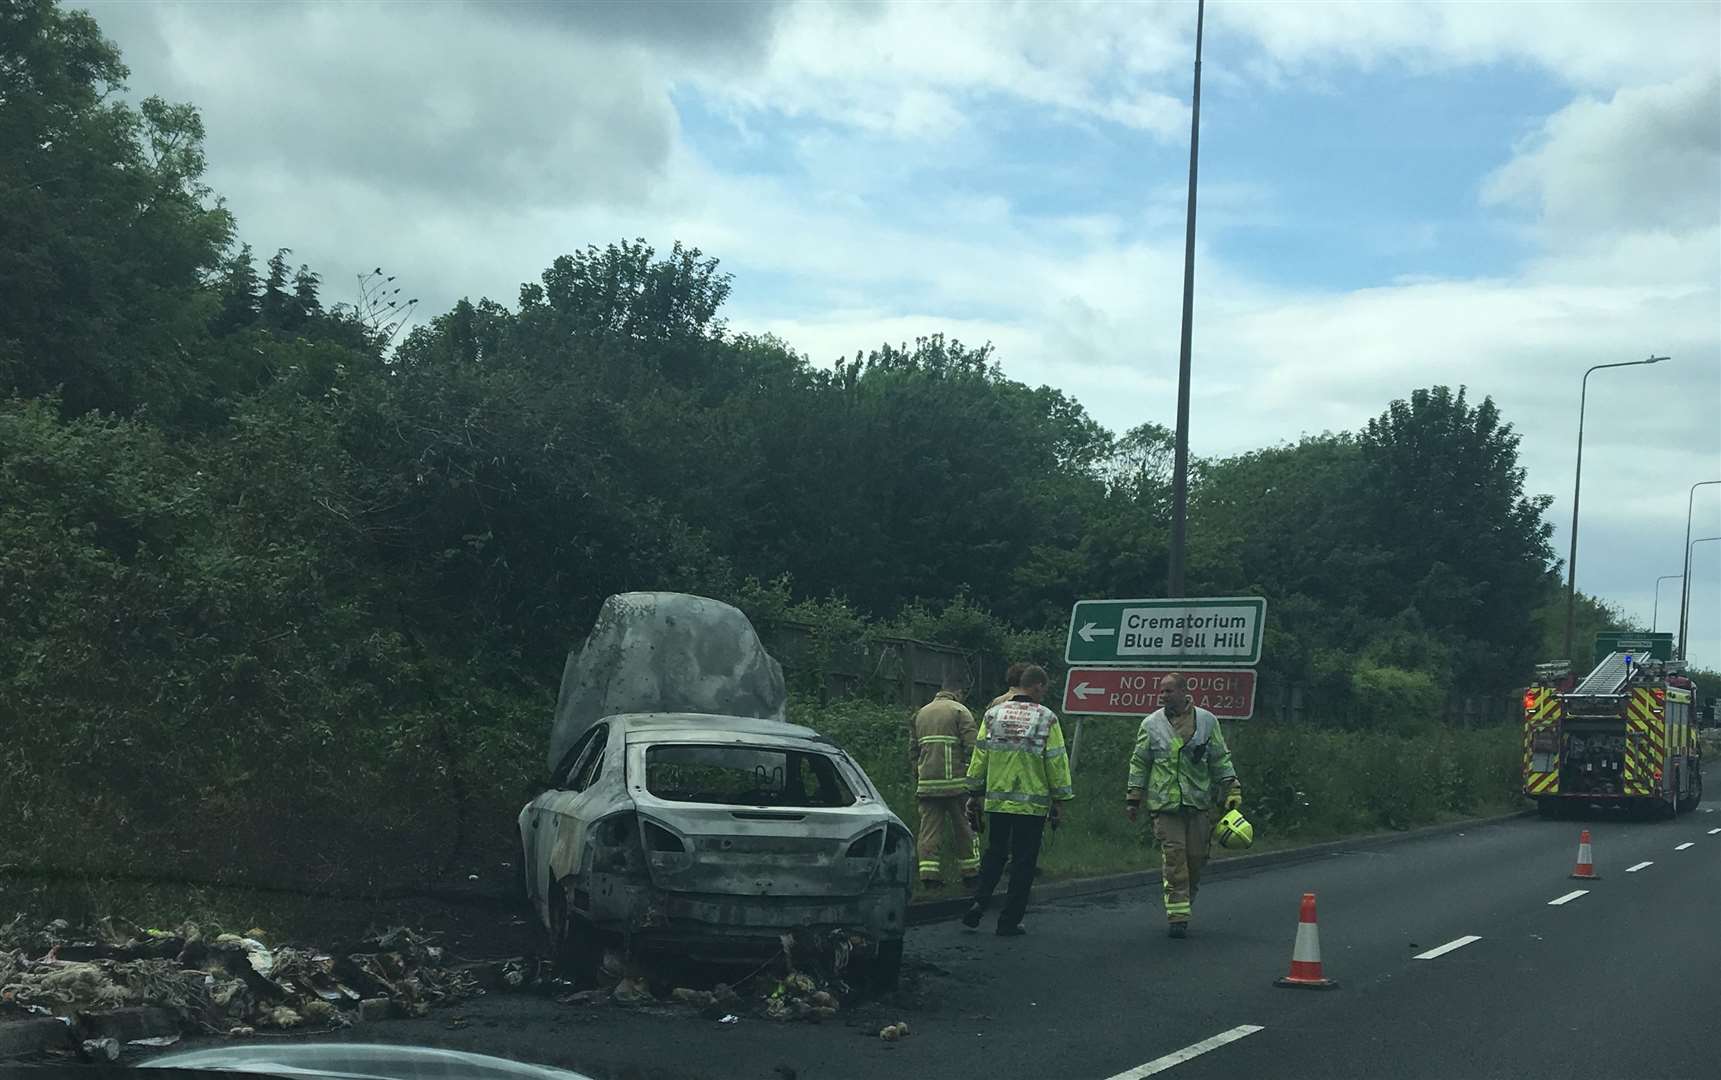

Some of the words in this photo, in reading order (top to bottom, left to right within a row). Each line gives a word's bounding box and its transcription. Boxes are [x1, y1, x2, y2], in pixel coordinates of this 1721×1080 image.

[1127, 614, 1246, 629] Crematorium
[1124, 633, 1163, 648] Blue
[1170, 633, 1206, 648] Bell
[1213, 633, 1246, 648] Hill
[1119, 676, 1146, 690] NO
[1151, 676, 1239, 691] TOUGH
[1109, 692, 1166, 707] ROUTE
